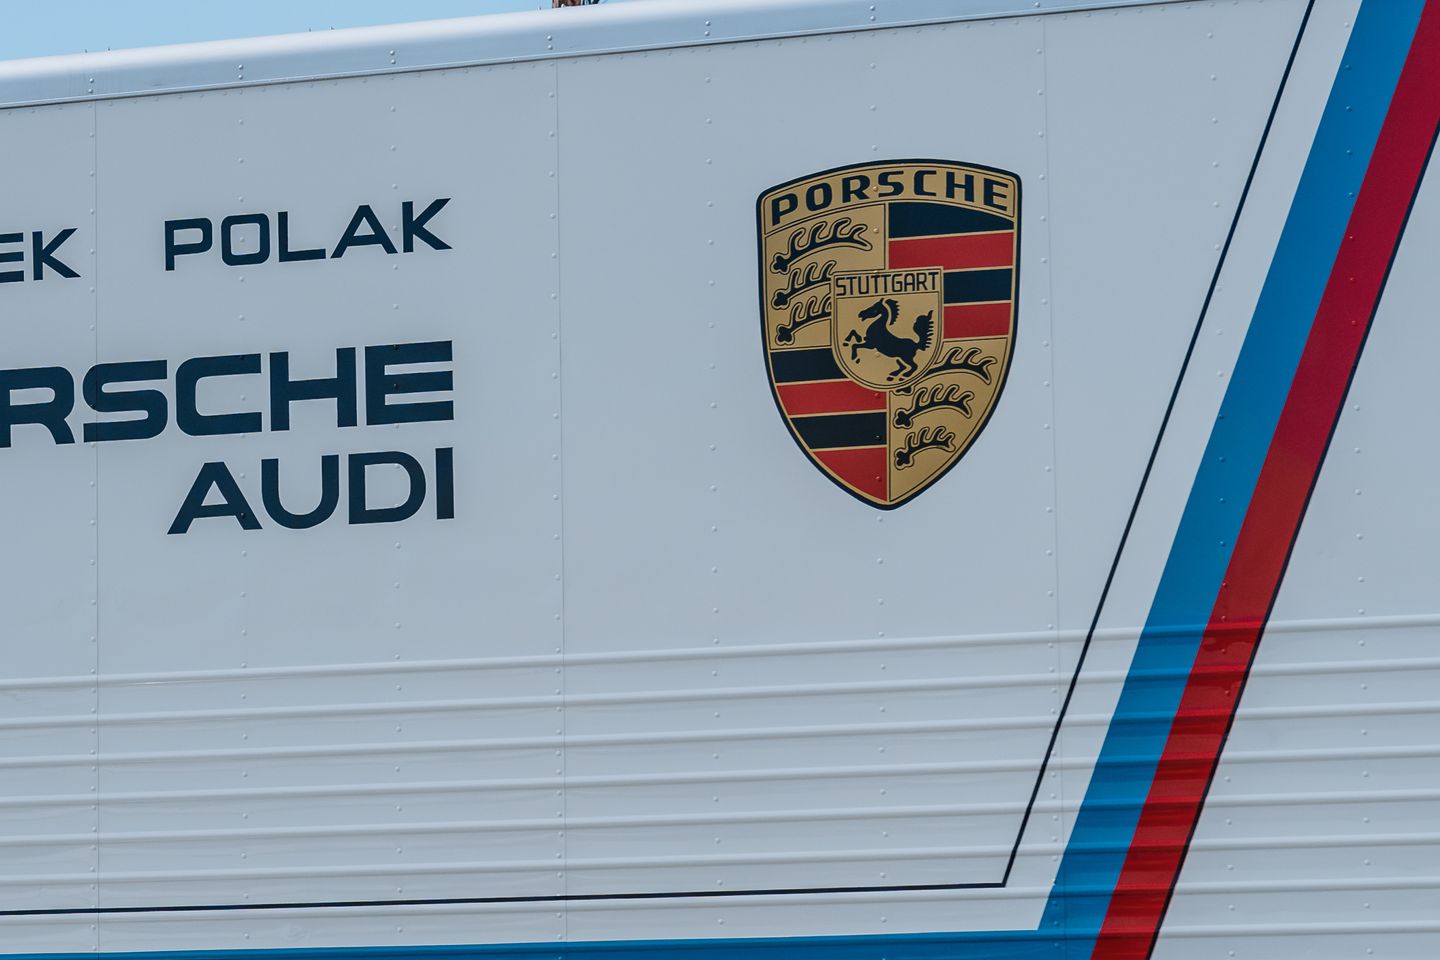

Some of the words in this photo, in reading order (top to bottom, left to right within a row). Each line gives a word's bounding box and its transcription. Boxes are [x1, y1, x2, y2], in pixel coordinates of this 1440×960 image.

[771, 169, 1009, 227] PORSCHE
[164, 198, 454, 272] POLAK
[835, 271, 939, 296] STUTTGART
[166, 446, 455, 536] AUDI
